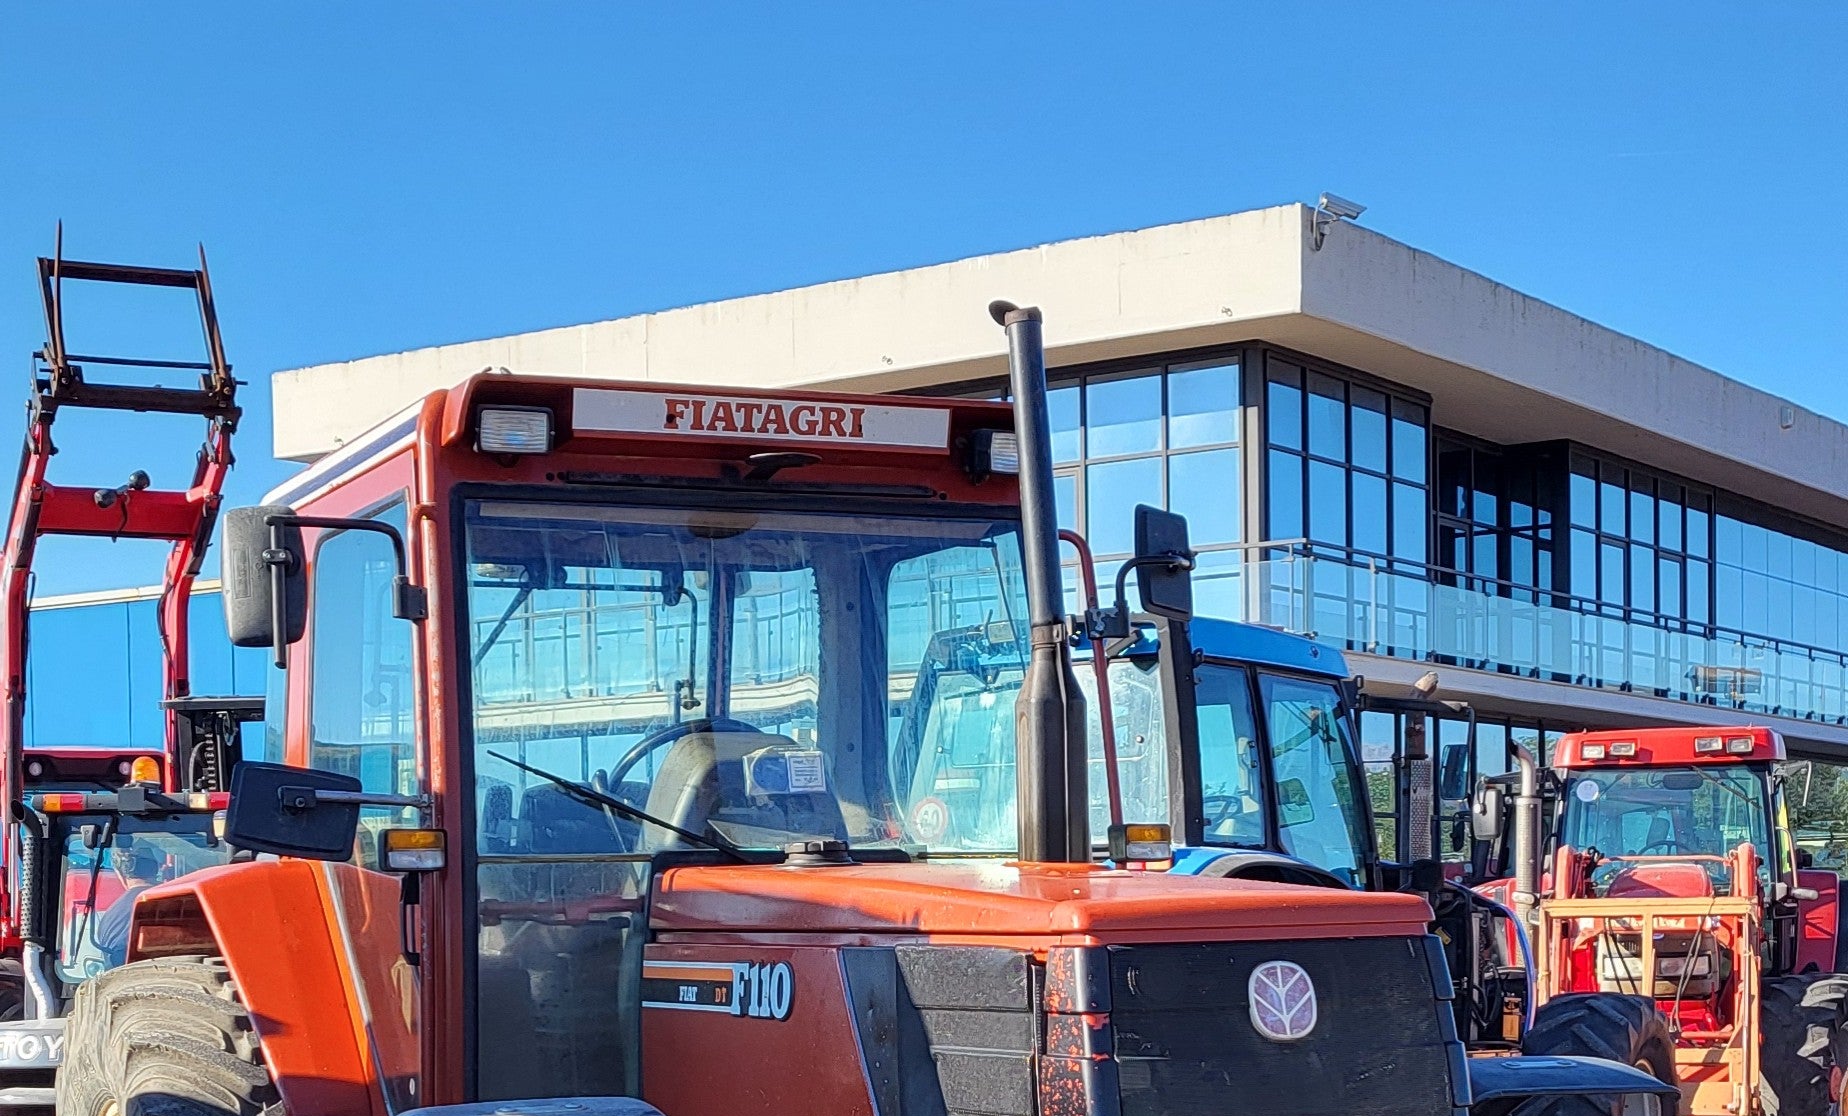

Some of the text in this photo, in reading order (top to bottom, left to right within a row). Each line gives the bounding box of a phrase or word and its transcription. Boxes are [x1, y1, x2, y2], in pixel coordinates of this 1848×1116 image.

[663, 398, 866, 438] FIATAGRI
[678, 961, 793, 1020] FIAT DT F110
